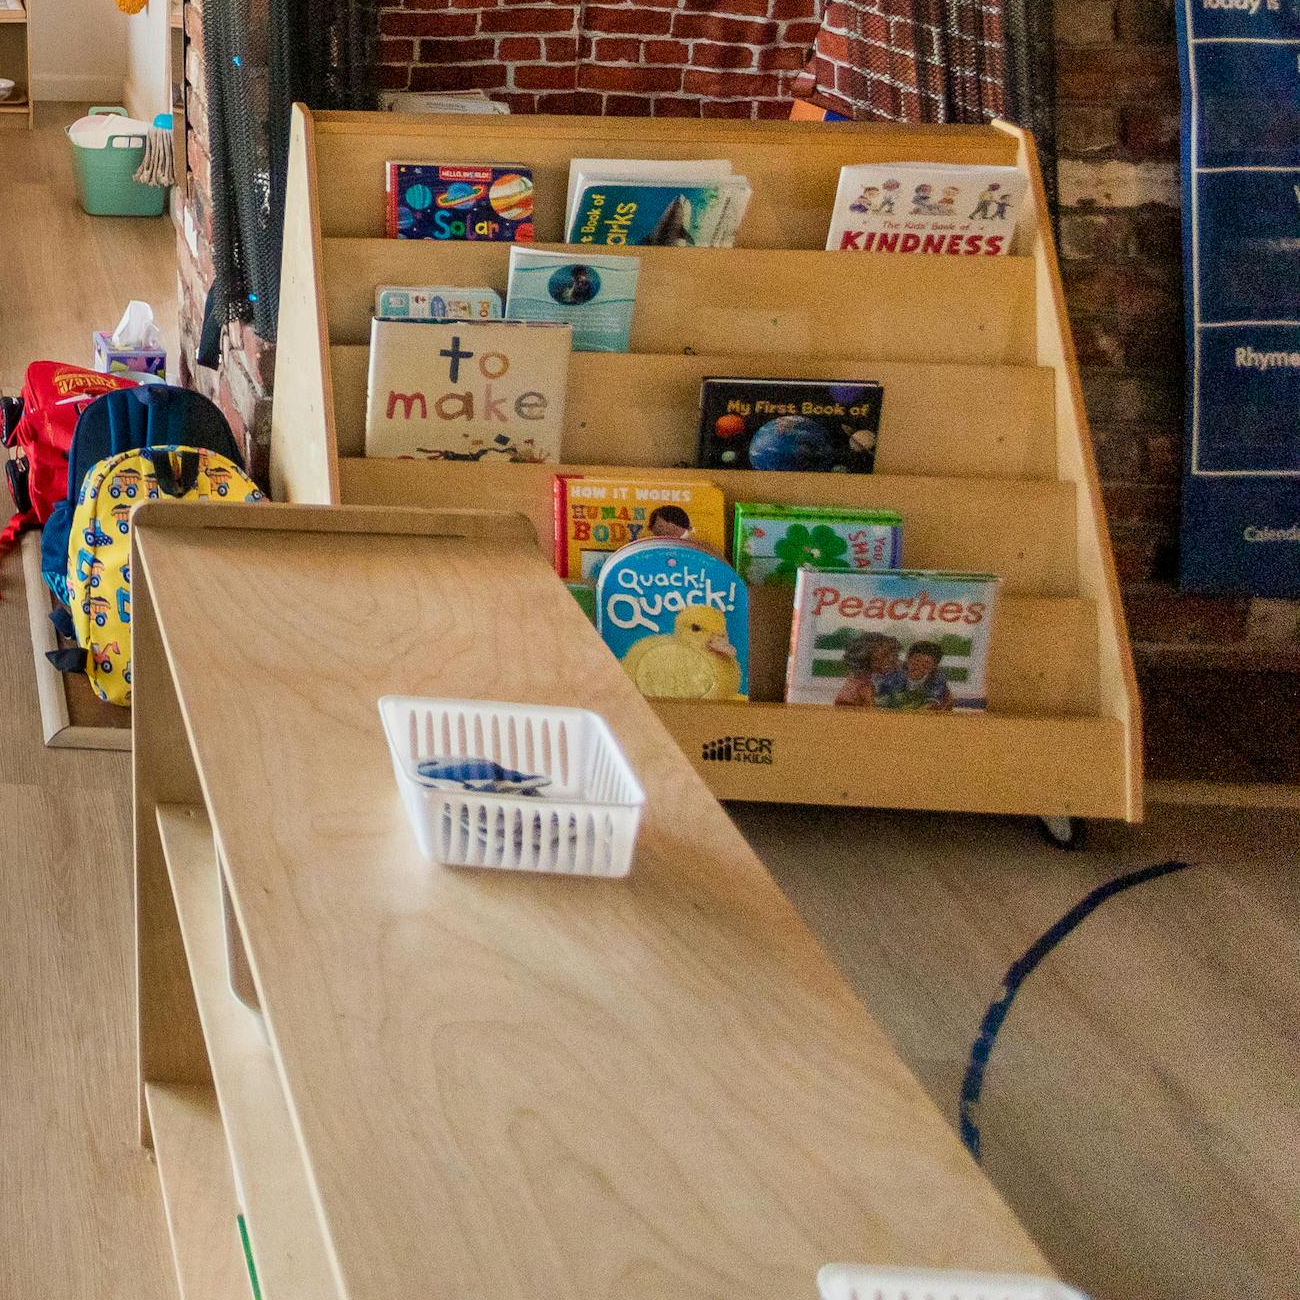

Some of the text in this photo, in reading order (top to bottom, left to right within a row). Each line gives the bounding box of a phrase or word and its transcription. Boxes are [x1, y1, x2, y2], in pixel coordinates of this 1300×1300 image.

[432, 209, 499, 240] Solar
[604, 202, 638, 246] arks
[883, 220, 900, 230] The
[931, 222, 955, 231] Book
[840, 230, 1004, 256] KINDNESS
[439, 335, 510, 384] to
[385, 383, 548, 423] make
[727, 399, 870, 416] My First Book of
[571, 486, 693, 502] HOW IT WORKS
[571, 504, 647, 521] HUMAN
[573, 520, 644, 543] BODY
[848, 530, 872, 569] SHA
[617, 566, 706, 595] Quack!
[606, 579, 737, 633] Quack!
[811, 586, 987, 625] Peaches
[733, 736, 772, 753] ECR
